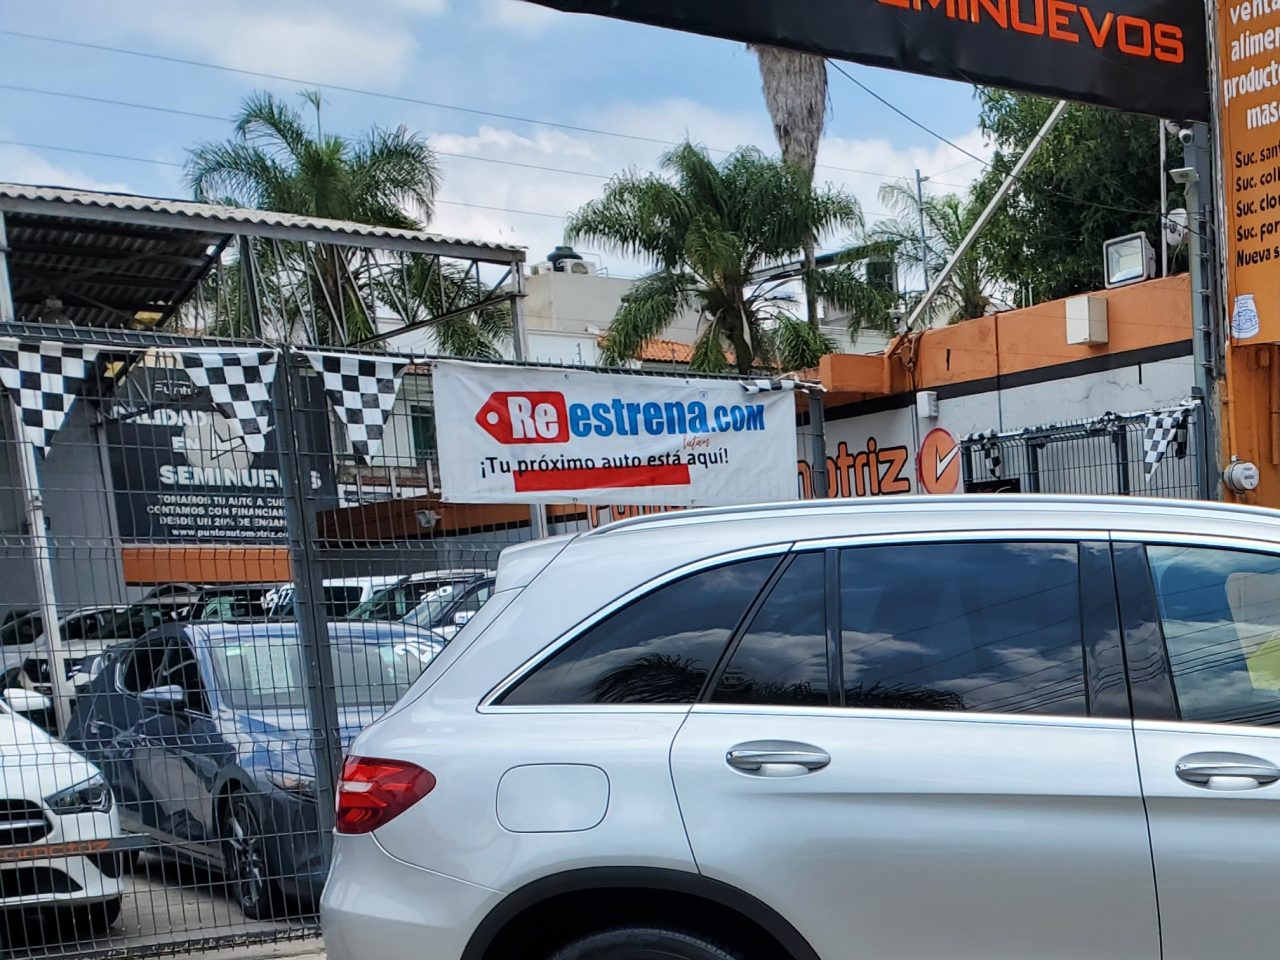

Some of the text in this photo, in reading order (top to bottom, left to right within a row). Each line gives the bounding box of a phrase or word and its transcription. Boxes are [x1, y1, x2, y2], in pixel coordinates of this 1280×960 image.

[878, 0, 1185, 64] INUEVOS
[1235, 150, 1258, 169] Suc.
[1236, 175, 1258, 193] Suc.
[1236, 199, 1258, 218] Suc.
[1237, 225, 1258, 242] Suc.
[1236, 246, 1272, 268] Nueva
[172, 435, 200, 453] EN
[480, 447, 729, 479] ¡Tu próximo auto está aquí!
[159, 464, 323, 490] SEMINUEVS
[157, 494, 211, 505] TOMAMOS
[213, 496, 225, 505] TU
[228, 497, 253, 507] AUTO
[256, 498, 264, 507] A
[146, 505, 206, 516] CONTAMOS
[208, 507, 230, 516] CON
[159, 516, 195, 526] DESDE
